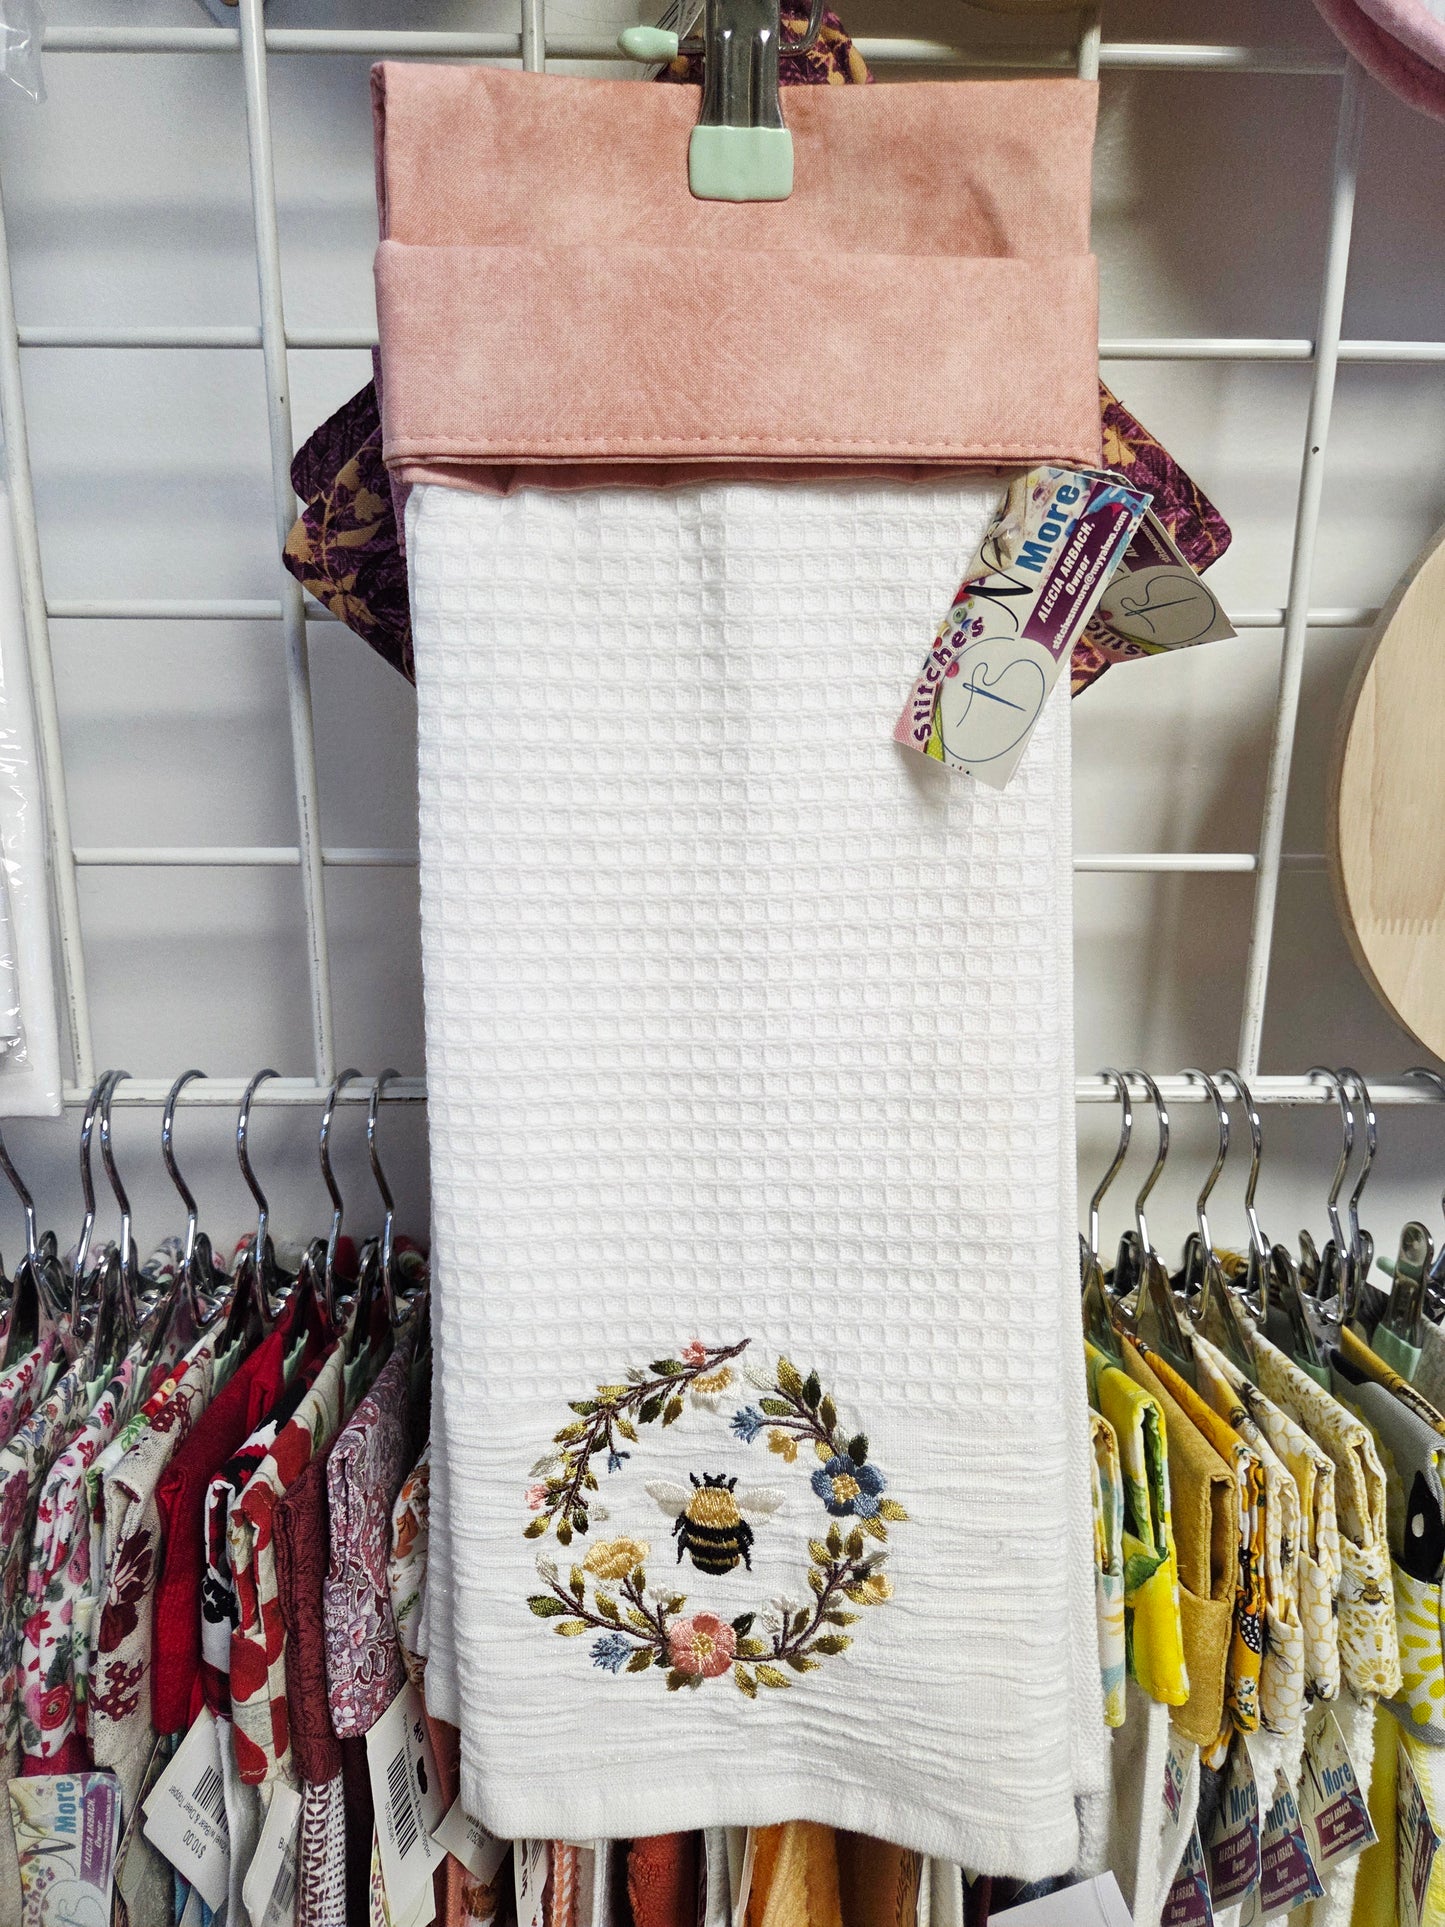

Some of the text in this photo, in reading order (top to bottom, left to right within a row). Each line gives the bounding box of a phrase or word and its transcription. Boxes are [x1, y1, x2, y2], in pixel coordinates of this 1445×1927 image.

[1037, 521, 1096, 623] ALECIA ARBACH,
[1052, 511, 1129, 650] stitchesnmore@myyahoo.com
[1065, 555, 1091, 596] Owner
[914, 616, 984, 741] Stitches
[1015, 484, 1080, 573] More
[168, 1785, 185, 1808] Topper
[1321, 1762, 1352, 1798] More
[54, 1781, 76, 1834] More
[183, 1802, 196, 1820] Deer
[1229, 1779, 1256, 1824] More
[84, 1836, 95, 1868] ALECIA
[183, 1830, 206, 1859] $10.00
